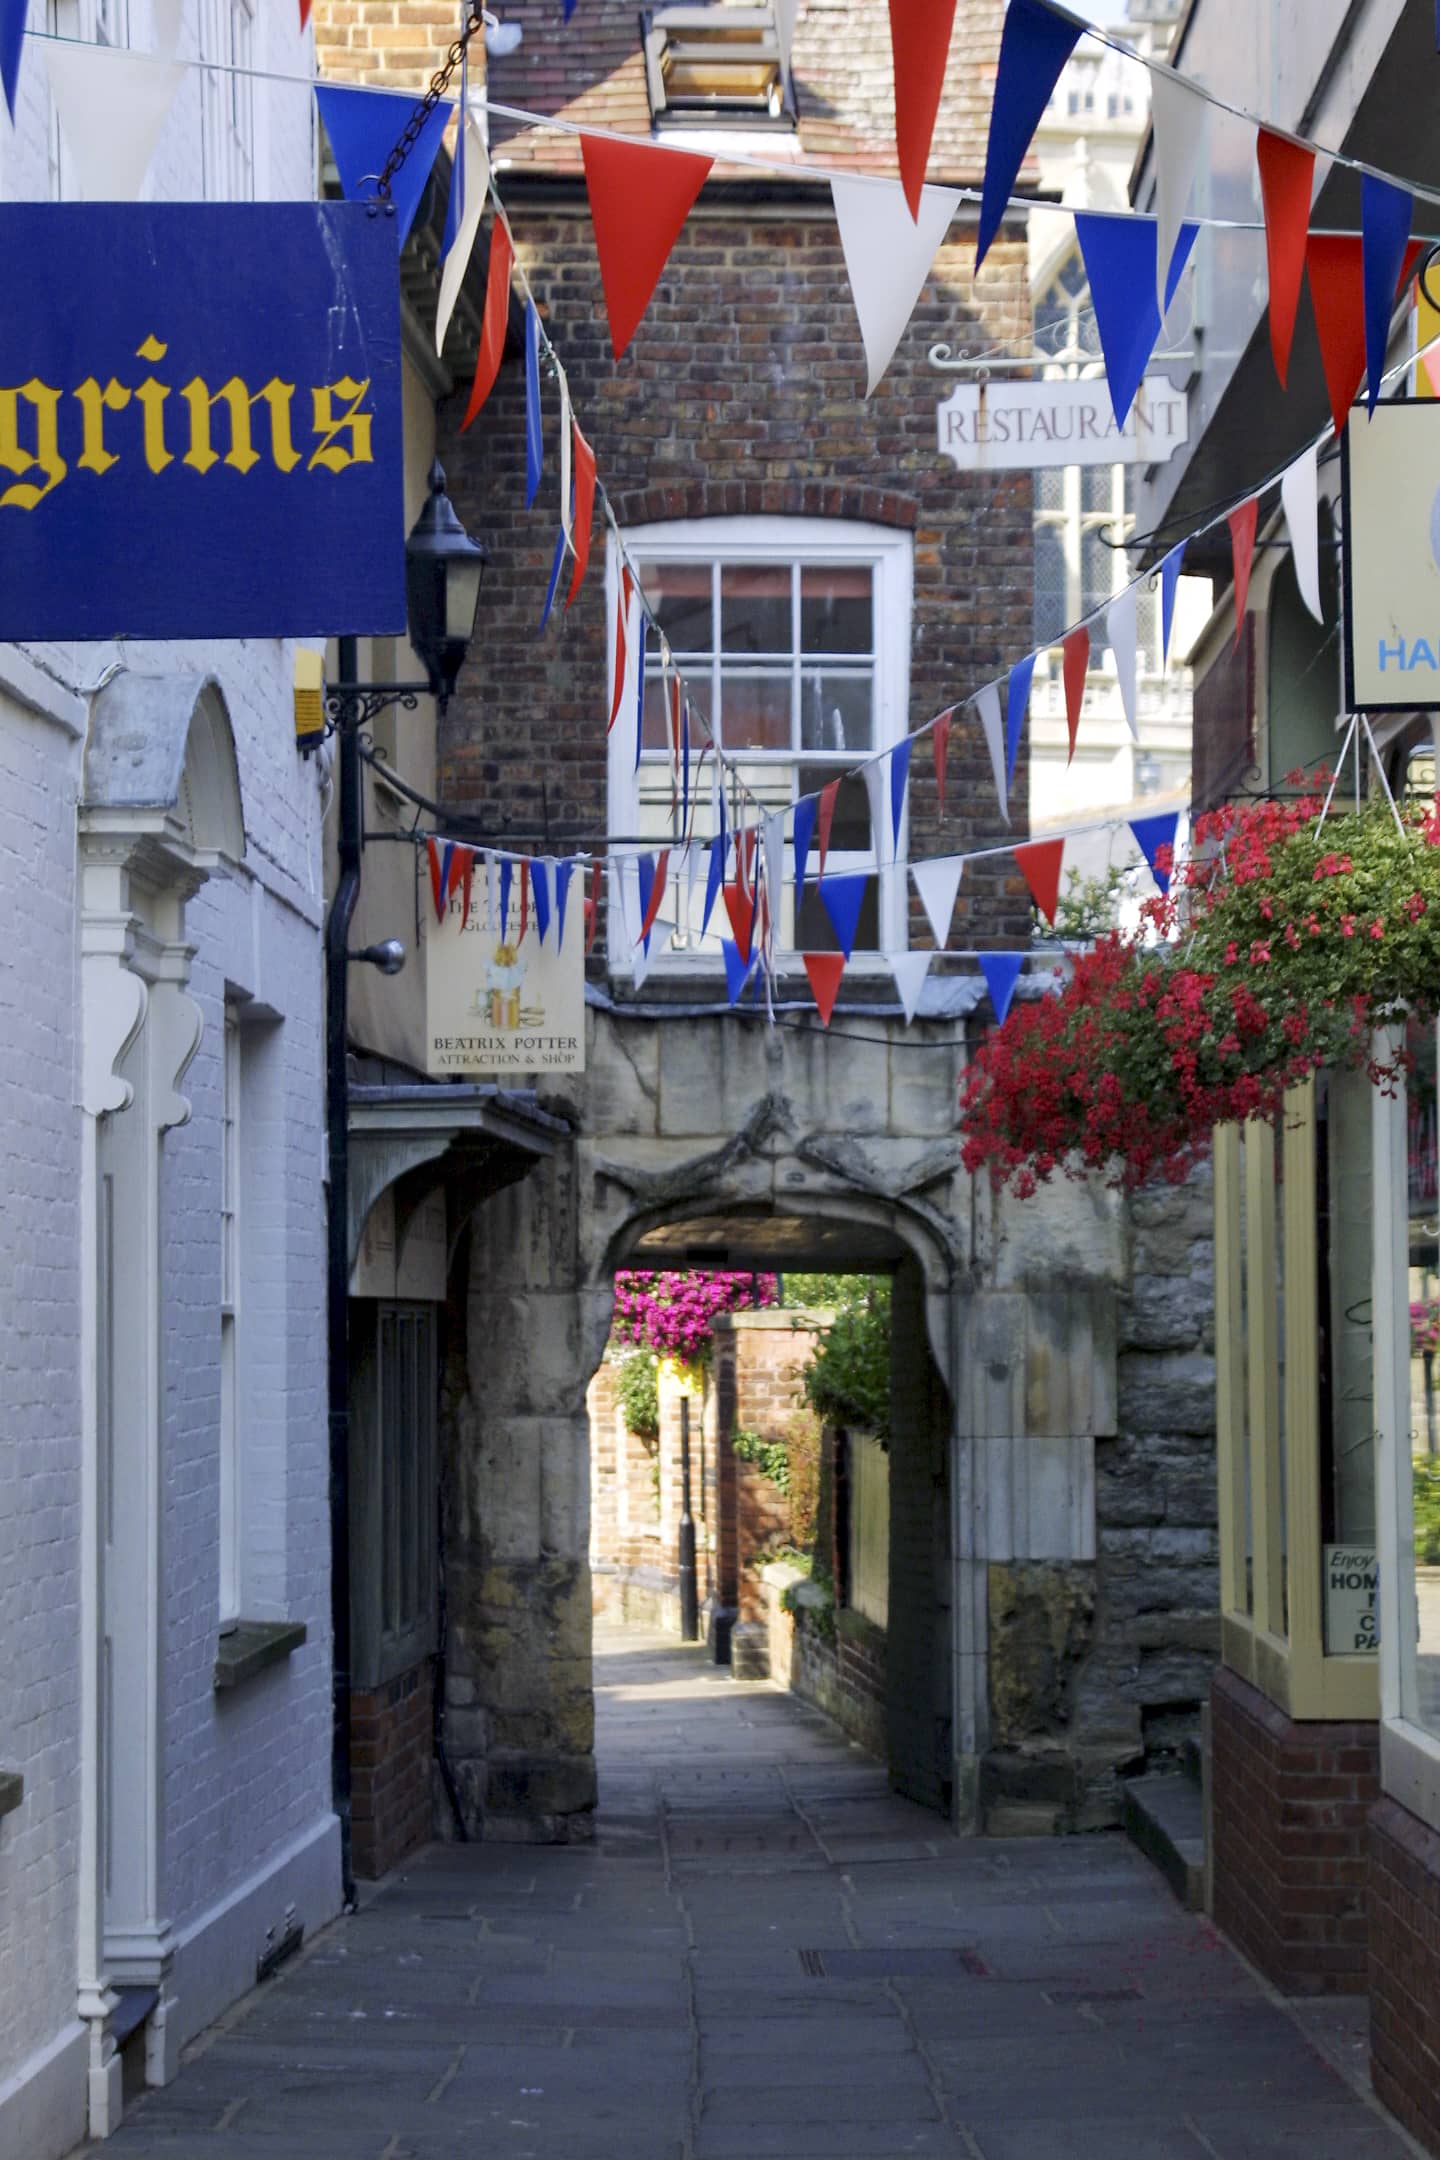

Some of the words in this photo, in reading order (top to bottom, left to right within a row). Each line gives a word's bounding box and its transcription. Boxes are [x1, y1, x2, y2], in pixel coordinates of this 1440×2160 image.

[0, 333, 374, 511] grims
[946, 400, 1181, 445] RESTAURANT
[1378, 639, 1440, 672] HA
[434, 1037, 506, 1049] BEATRIX
[514, 1037, 578, 1049] POTTER
[437, 1054, 520, 1065] ATTRACTION
[525, 1054, 535, 1064] &
[542, 1053, 576, 1064] SHOP
[1330, 1551, 1375, 1571] Enjoy
